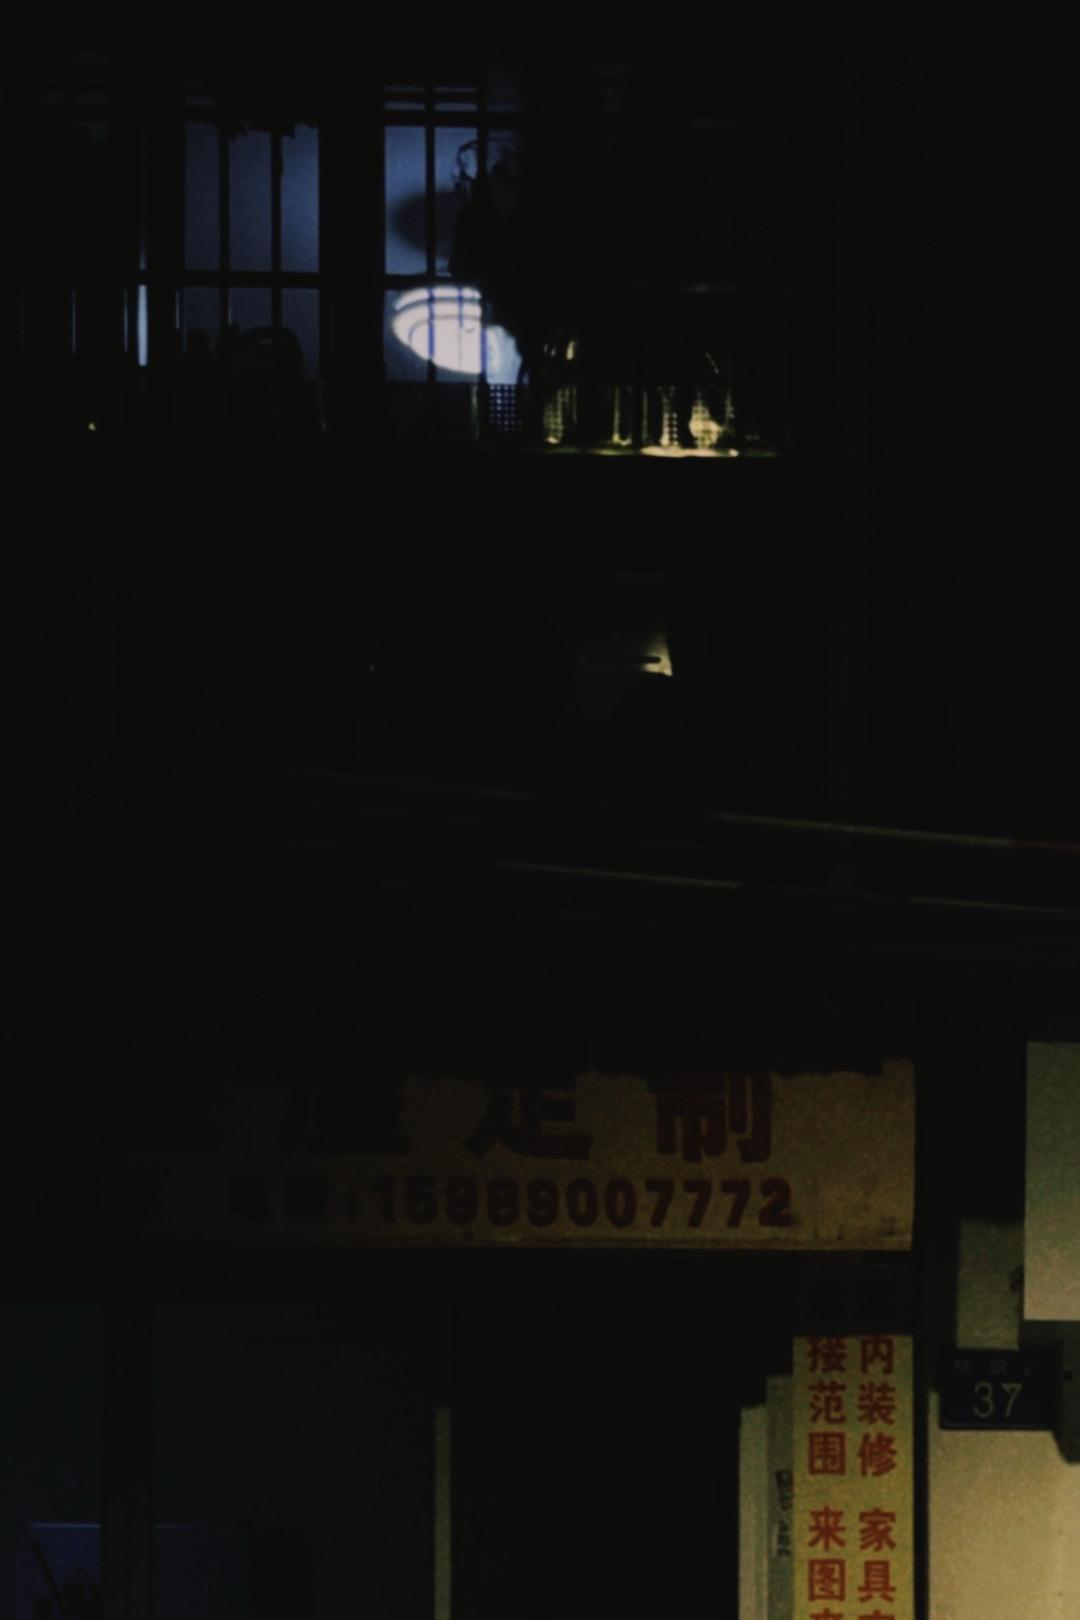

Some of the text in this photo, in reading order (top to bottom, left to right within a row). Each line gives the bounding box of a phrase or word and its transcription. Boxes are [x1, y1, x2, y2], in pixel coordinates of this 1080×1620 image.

[806, 1284, 848, 1477] 接范围
[856, 1284, 897, 1477] 内装修
[972, 1380, 1024, 1420] 37
